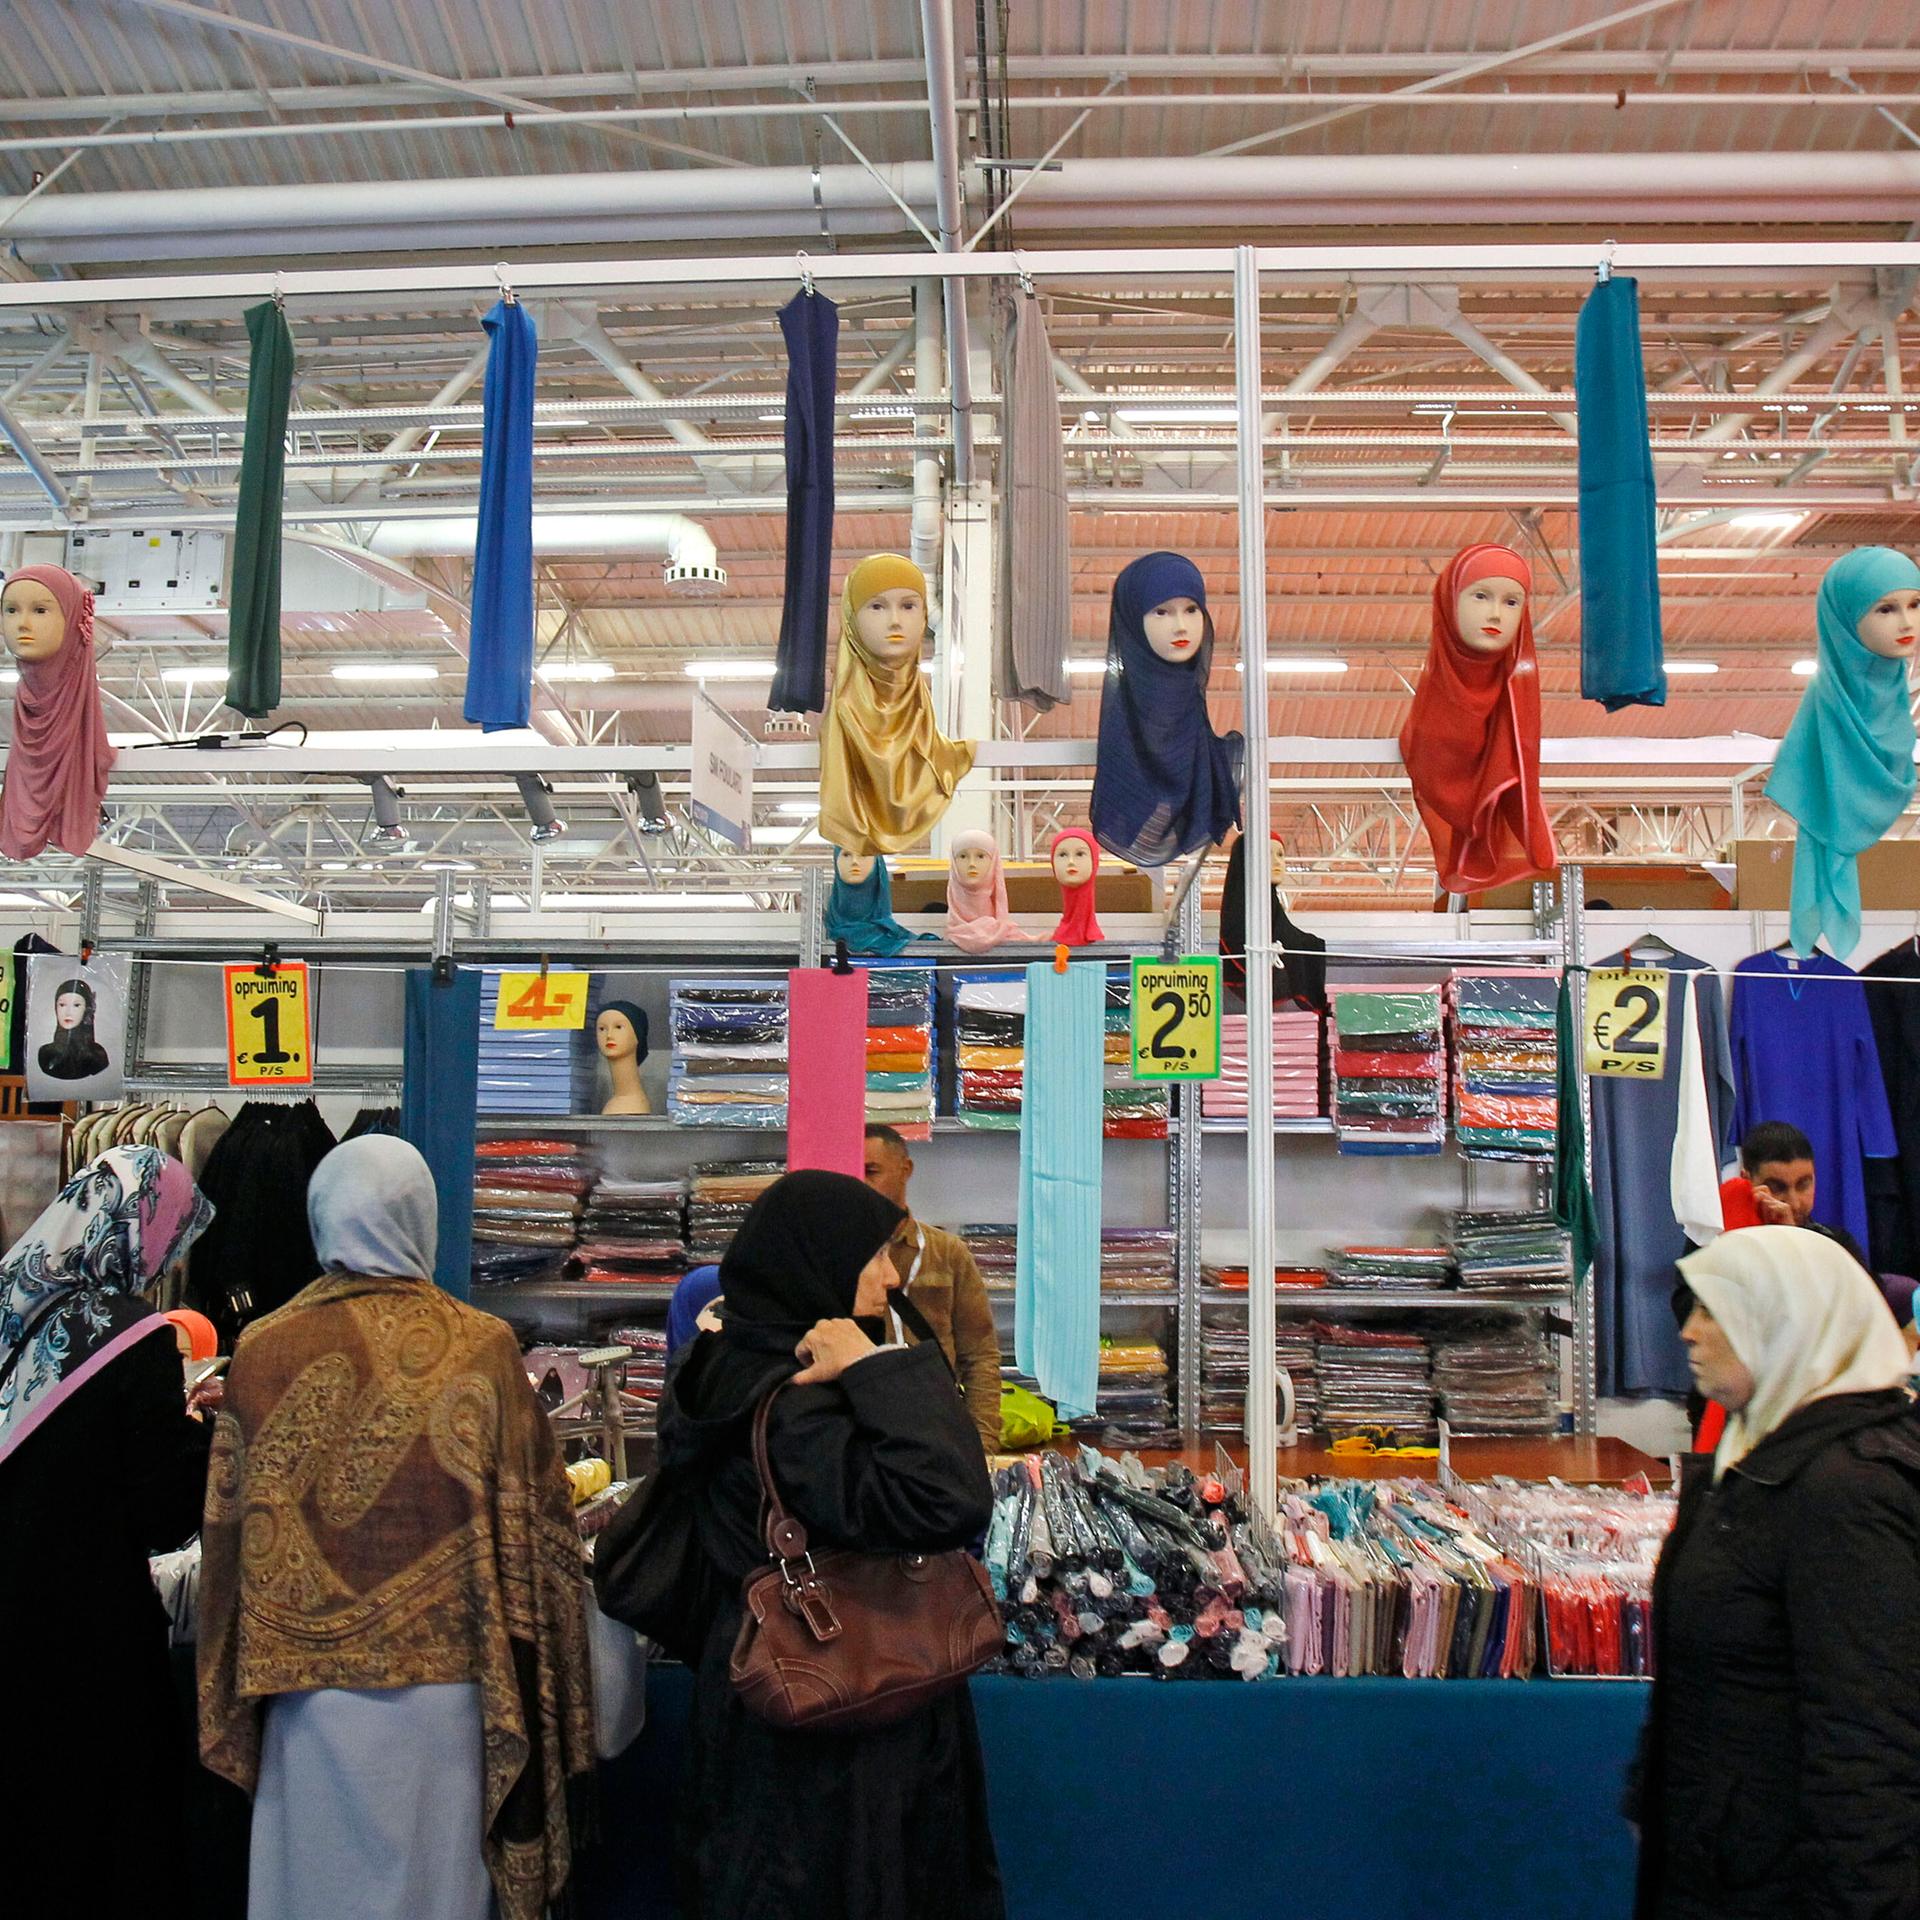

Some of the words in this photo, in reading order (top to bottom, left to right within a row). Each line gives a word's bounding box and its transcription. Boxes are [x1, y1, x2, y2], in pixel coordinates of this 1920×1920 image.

[235, 976, 297, 999] opruiming
[1141, 970, 1209, 993] opruiming
[260, 1066, 284, 1076] P/S
[1164, 1061, 1189, 1071] P/S
[1601, 1059, 1656, 1072] P/S
